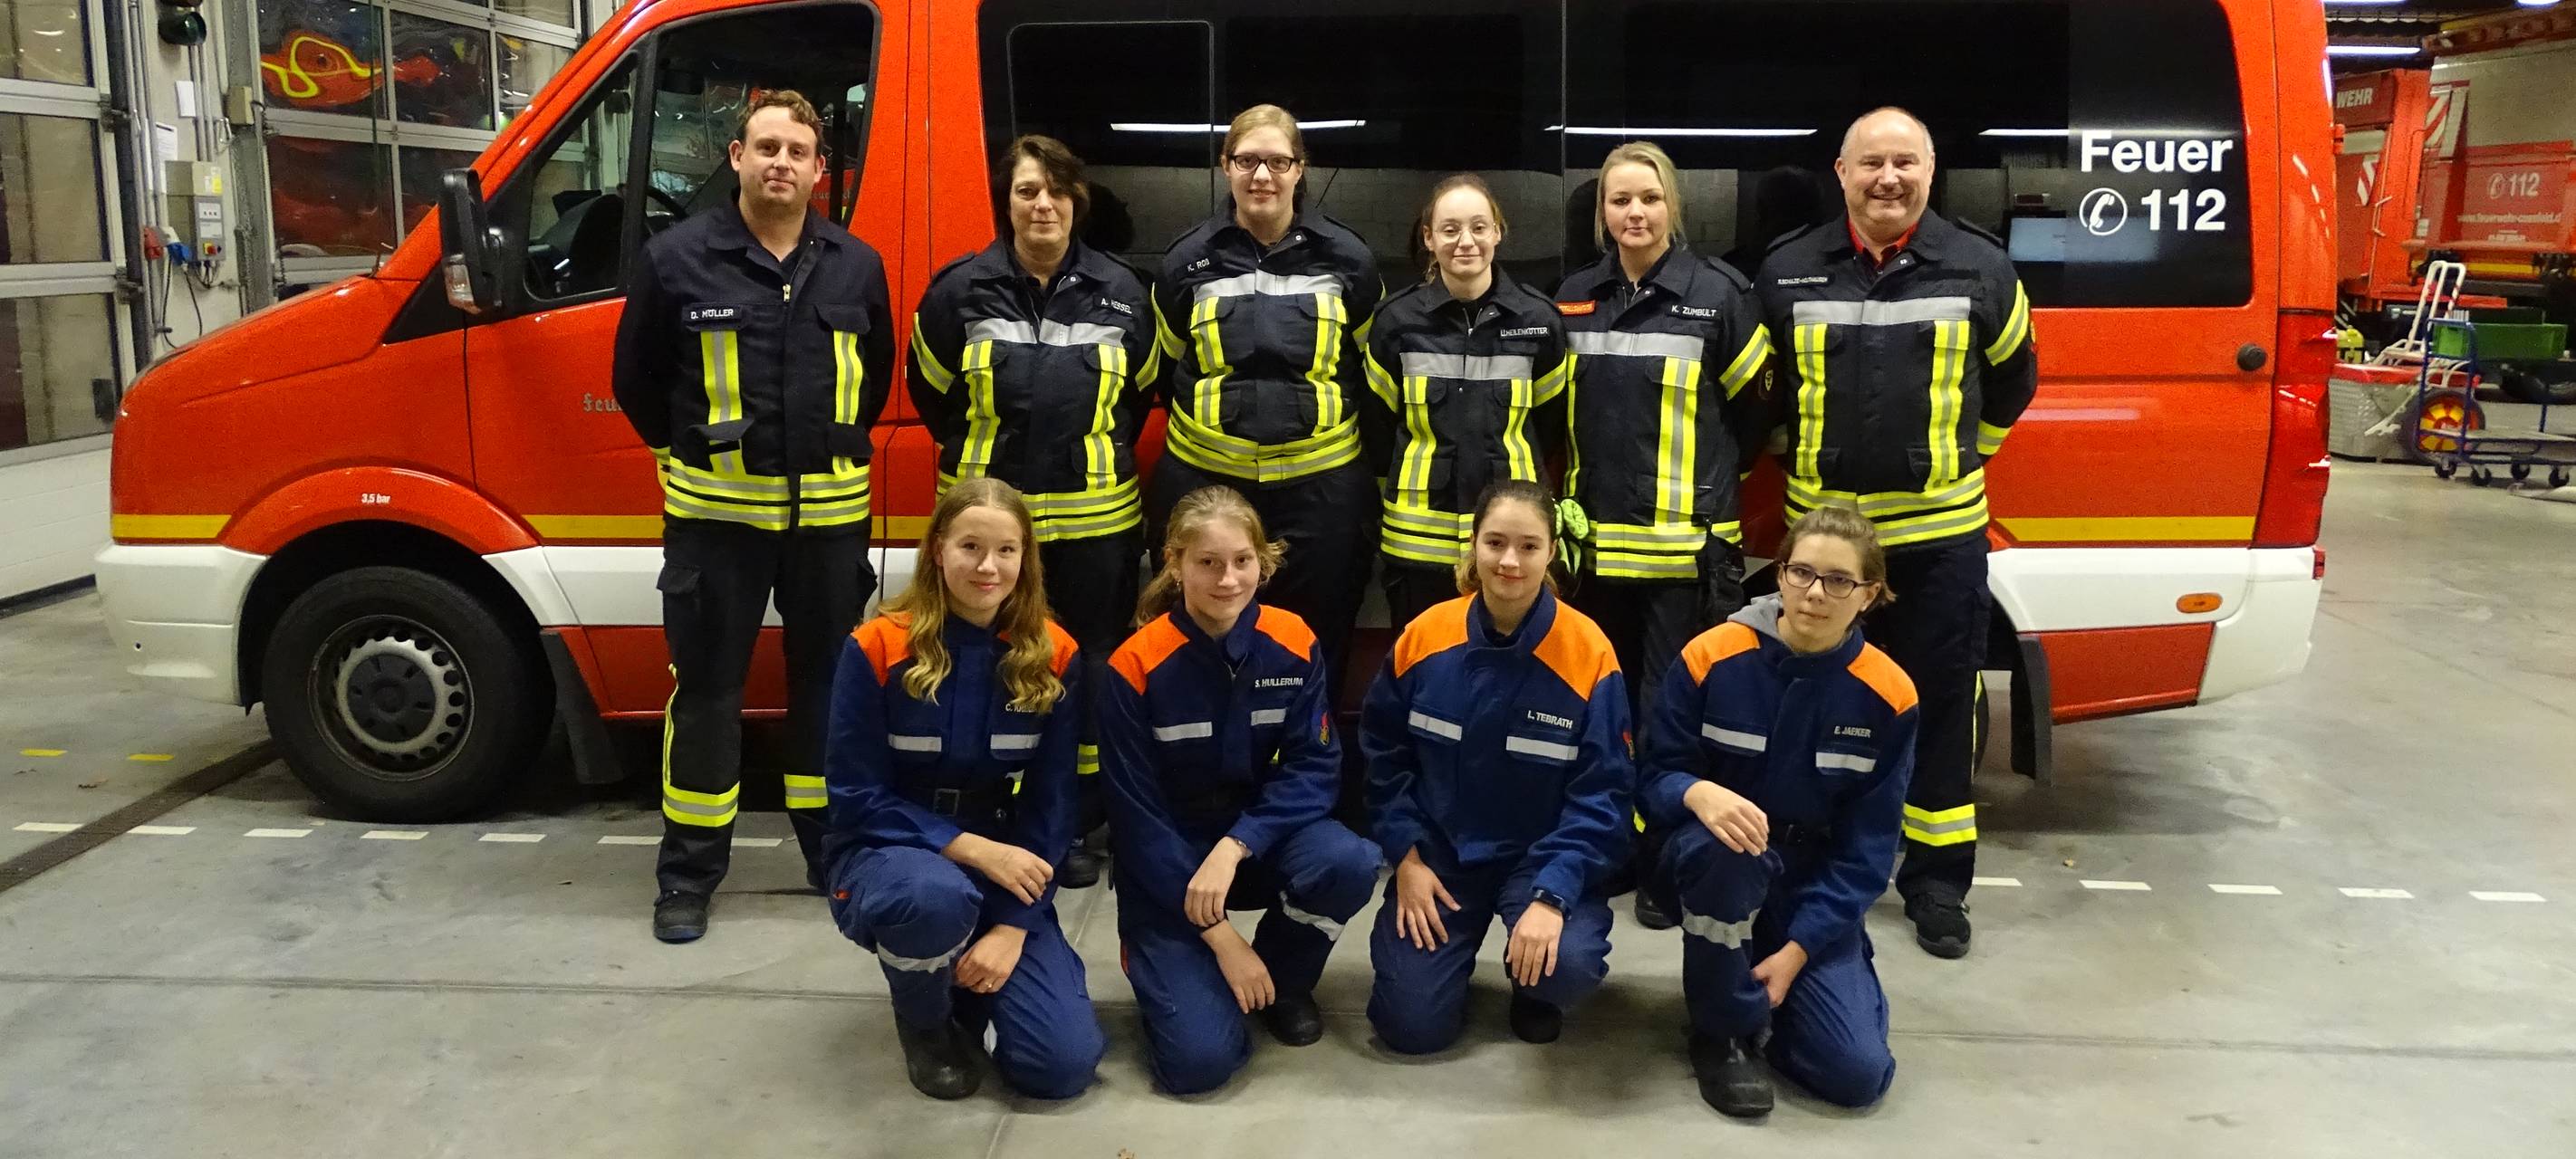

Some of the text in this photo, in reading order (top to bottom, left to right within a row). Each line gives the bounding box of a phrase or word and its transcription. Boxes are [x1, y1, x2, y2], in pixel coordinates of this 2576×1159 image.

[2081, 130, 2233, 172] Feuer
[2509, 172, 2540, 196] 112
[2141, 188, 2226, 231] 112
[690, 311, 699, 320] D.
[1671, 304, 1679, 312] K.
[361, 493, 391, 504] 3,5 bar
[1527, 710, 1573, 729] L. TEBRATH
